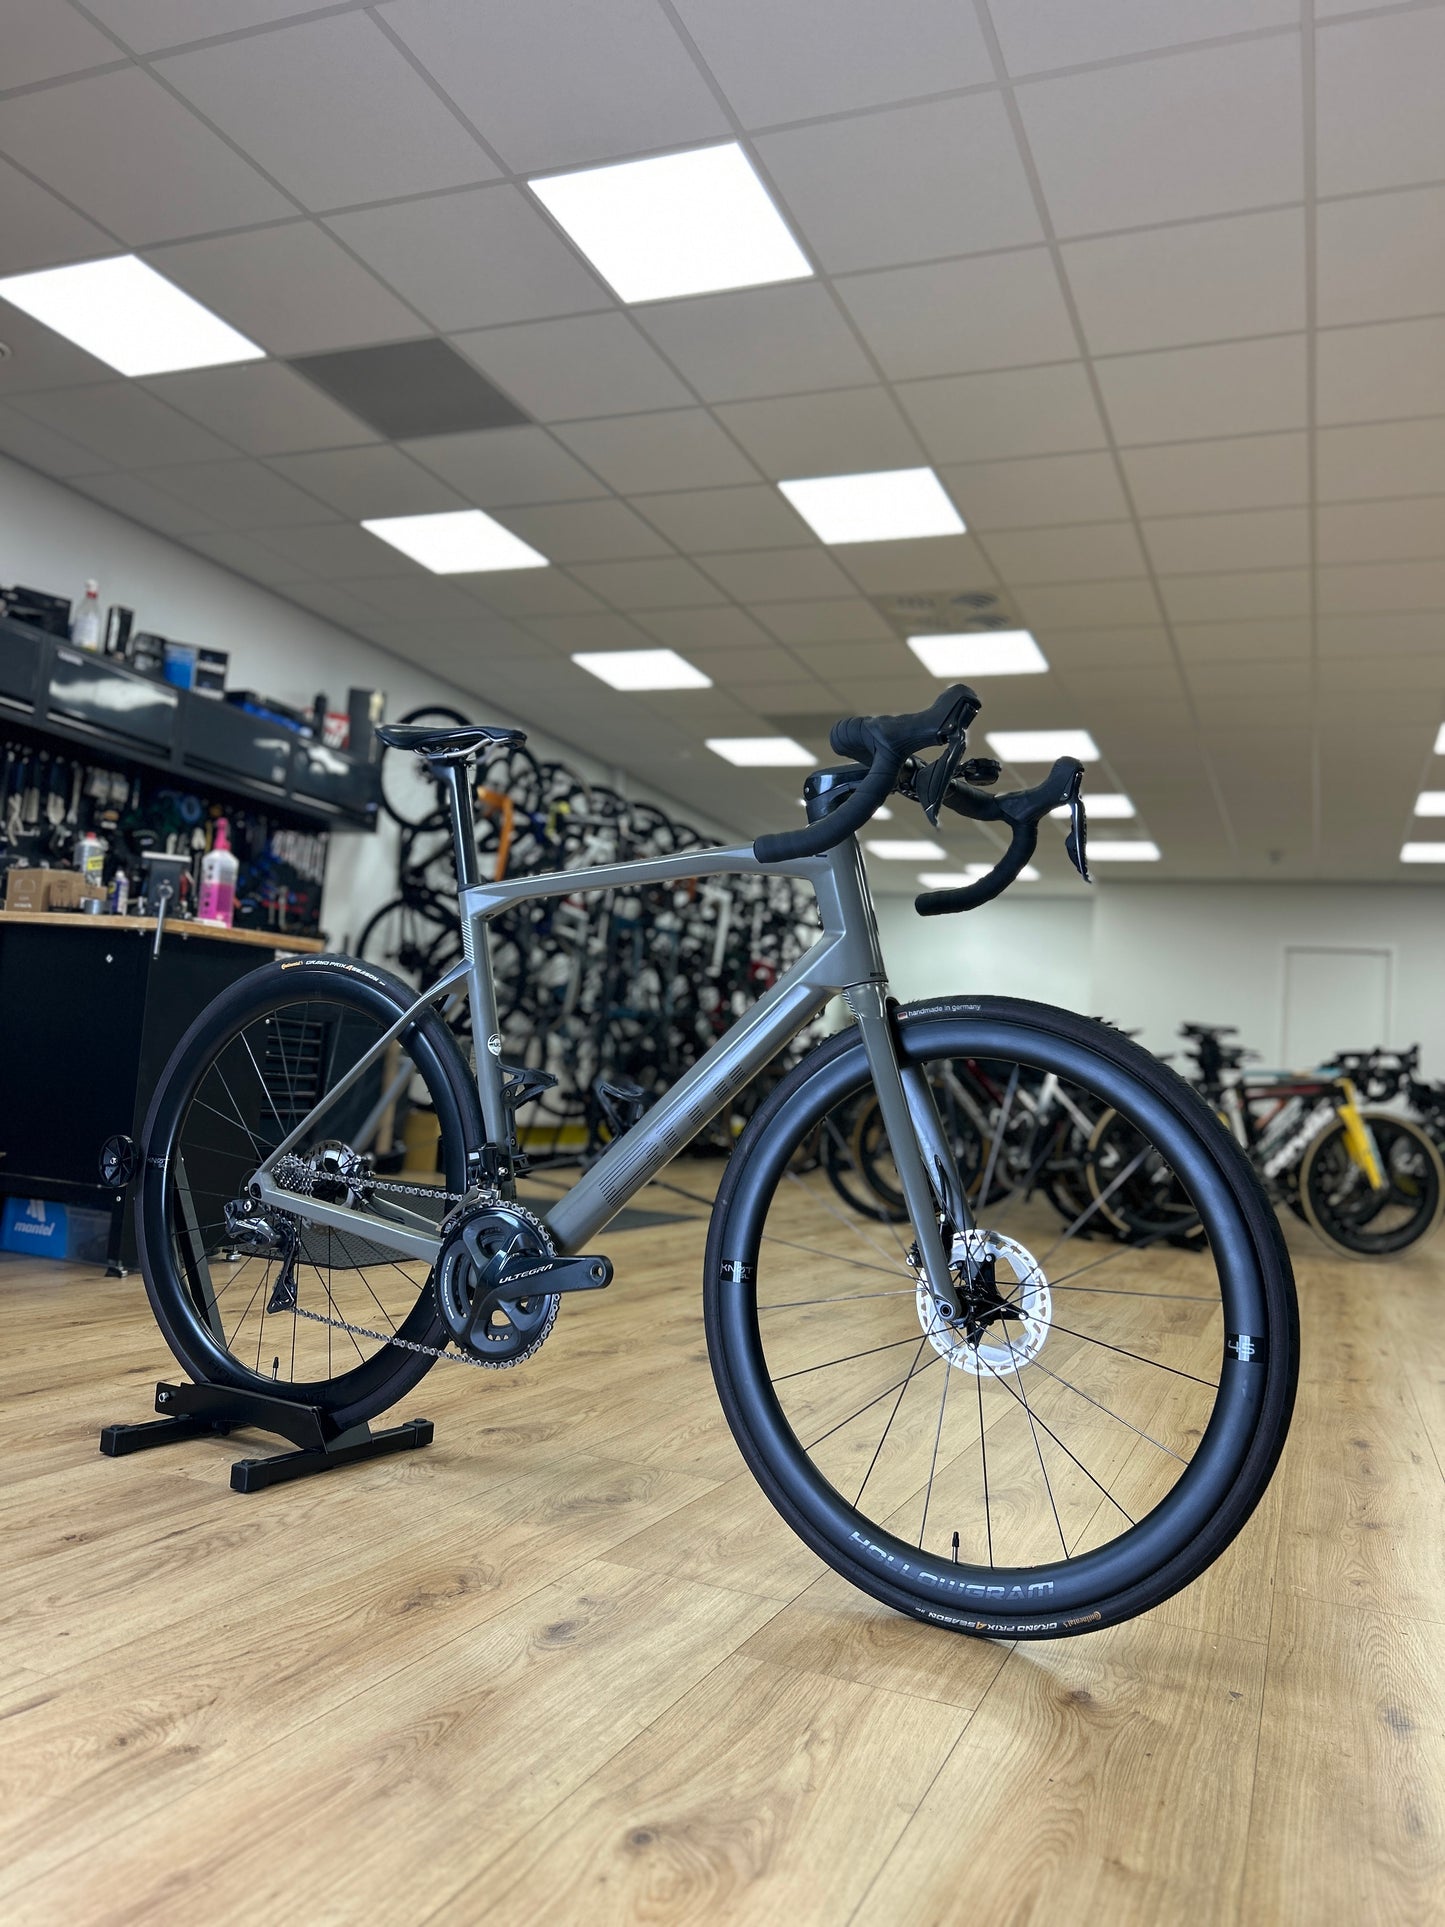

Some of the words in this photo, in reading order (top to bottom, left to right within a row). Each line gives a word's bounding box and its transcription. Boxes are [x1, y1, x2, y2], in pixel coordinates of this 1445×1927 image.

[908, 1006, 942, 1017] handmade
[951, 1004, 981, 1012] germany
[14, 1221, 55, 1237] mantel
[499, 1263, 553, 1284] ULTEGRA
[850, 1531, 1054, 1601] HOLLOWGRAM
[1017, 1622, 1058, 1631] GRAND
